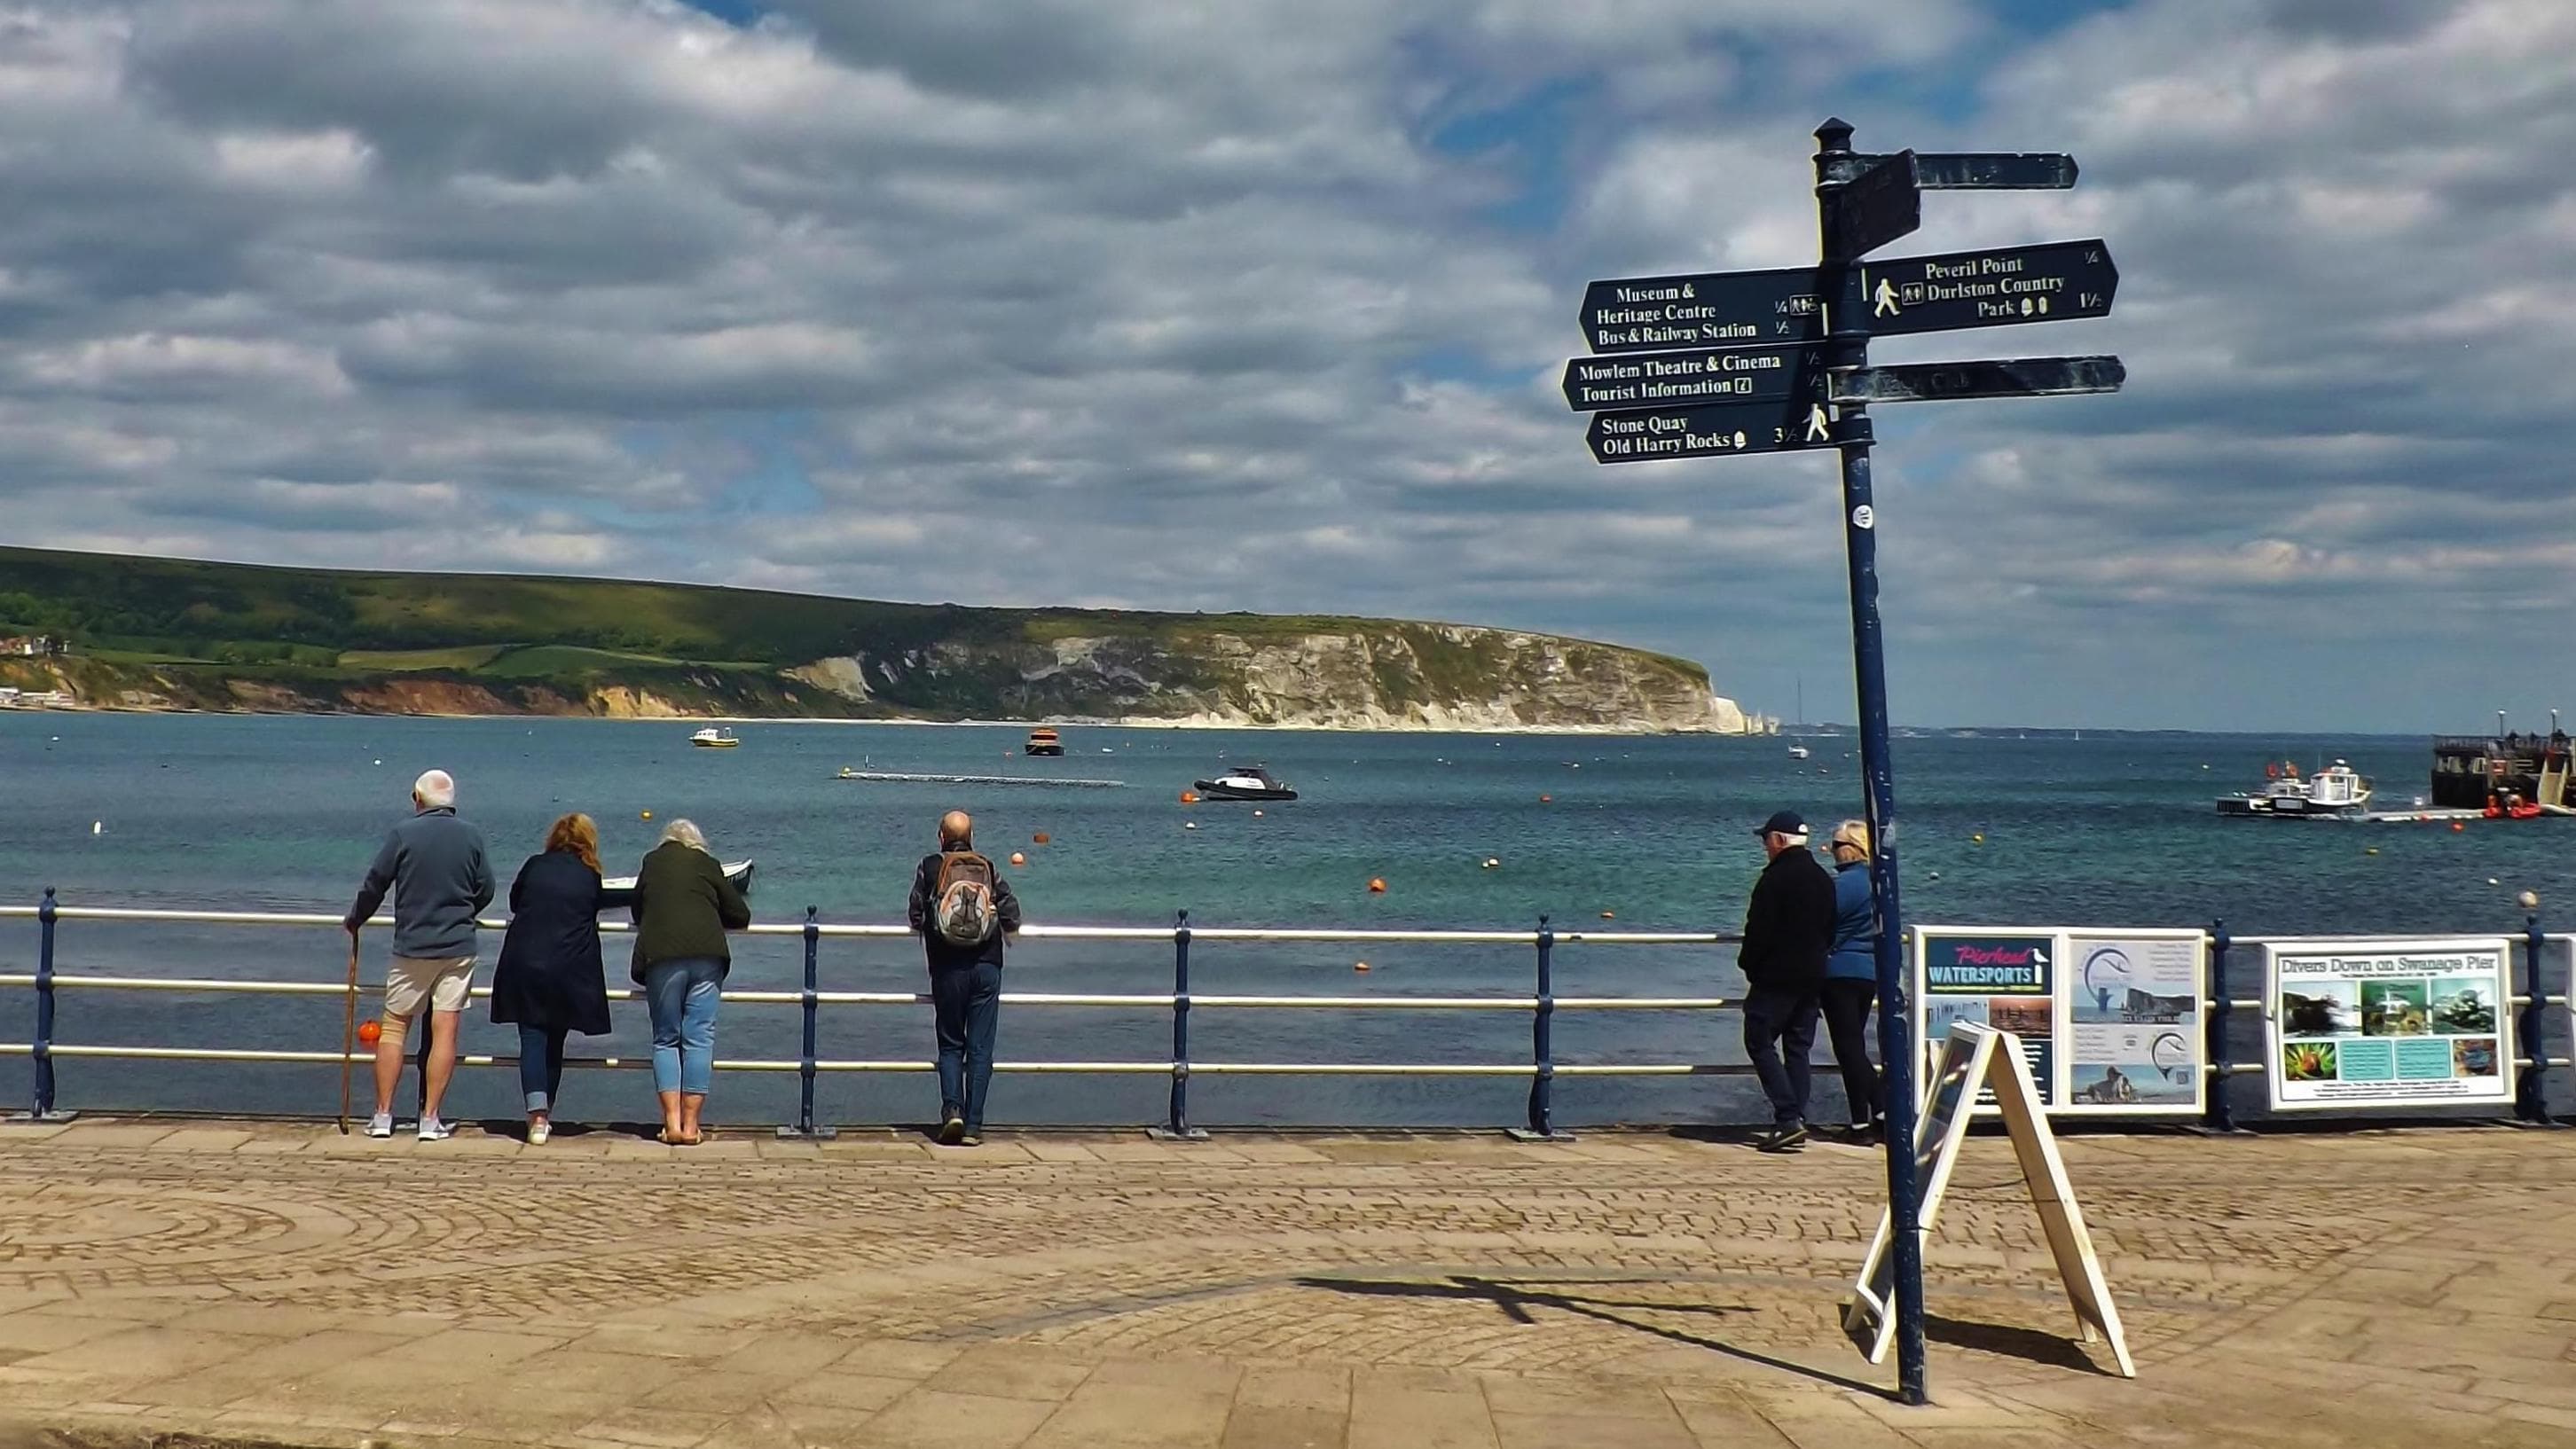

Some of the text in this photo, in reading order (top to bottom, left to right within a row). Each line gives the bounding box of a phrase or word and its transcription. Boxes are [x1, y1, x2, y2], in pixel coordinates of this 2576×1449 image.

[1925, 257, 2023, 279] Peveril Point
[1616, 284, 1695, 302] Museum &
[1928, 276, 2064, 301] Durlston Country
[1597, 304, 1716, 325] Heritage Centre
[1977, 300, 2016, 319] Park
[1598, 323, 1756, 345] Bus & Railway Station
[1579, 355, 1780, 381] Mowlem Theatre & Cinema
[1581, 386, 1636, 403] Tourist
[1641, 380, 1732, 398] Information
[1601, 416, 1688, 435] Stone Quay
[1603, 432, 1731, 455] Old Harry Rocks
[1955, 944, 2031, 965] Pierhead
[2281, 956, 2495, 974] Divers Down on Swanage Pier
[1928, 965, 2032, 984] WATERSPORTS
